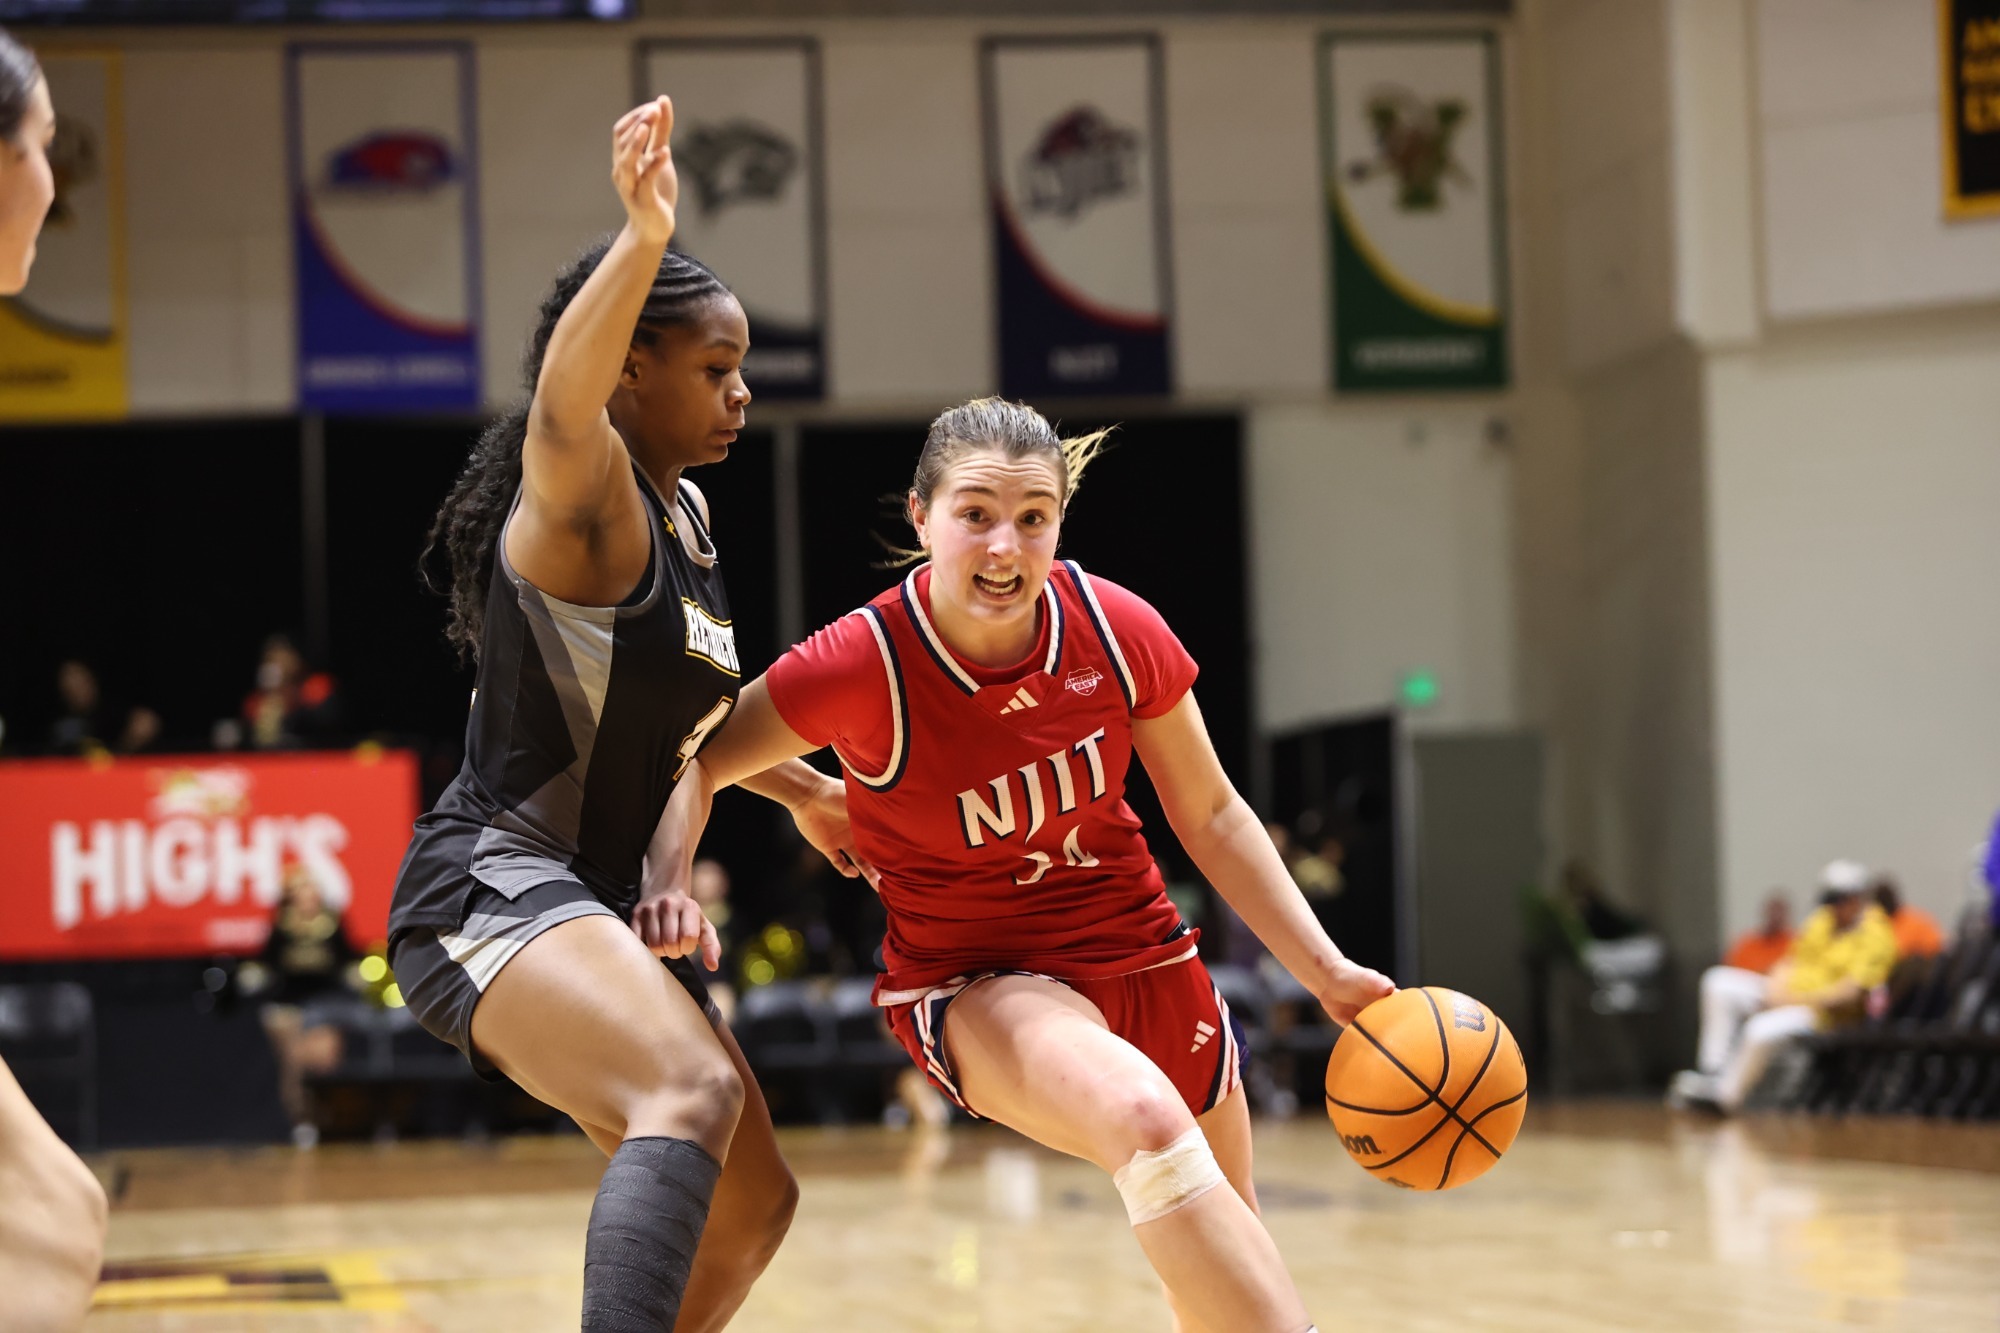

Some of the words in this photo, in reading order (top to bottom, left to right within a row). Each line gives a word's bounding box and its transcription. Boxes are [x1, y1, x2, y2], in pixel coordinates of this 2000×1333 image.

[1066, 671, 1101, 688] AMERICA
[1074, 680, 1095, 690] EAST
[956, 726, 1106, 849] NJIT
[52, 813, 353, 931] HIGH'S
